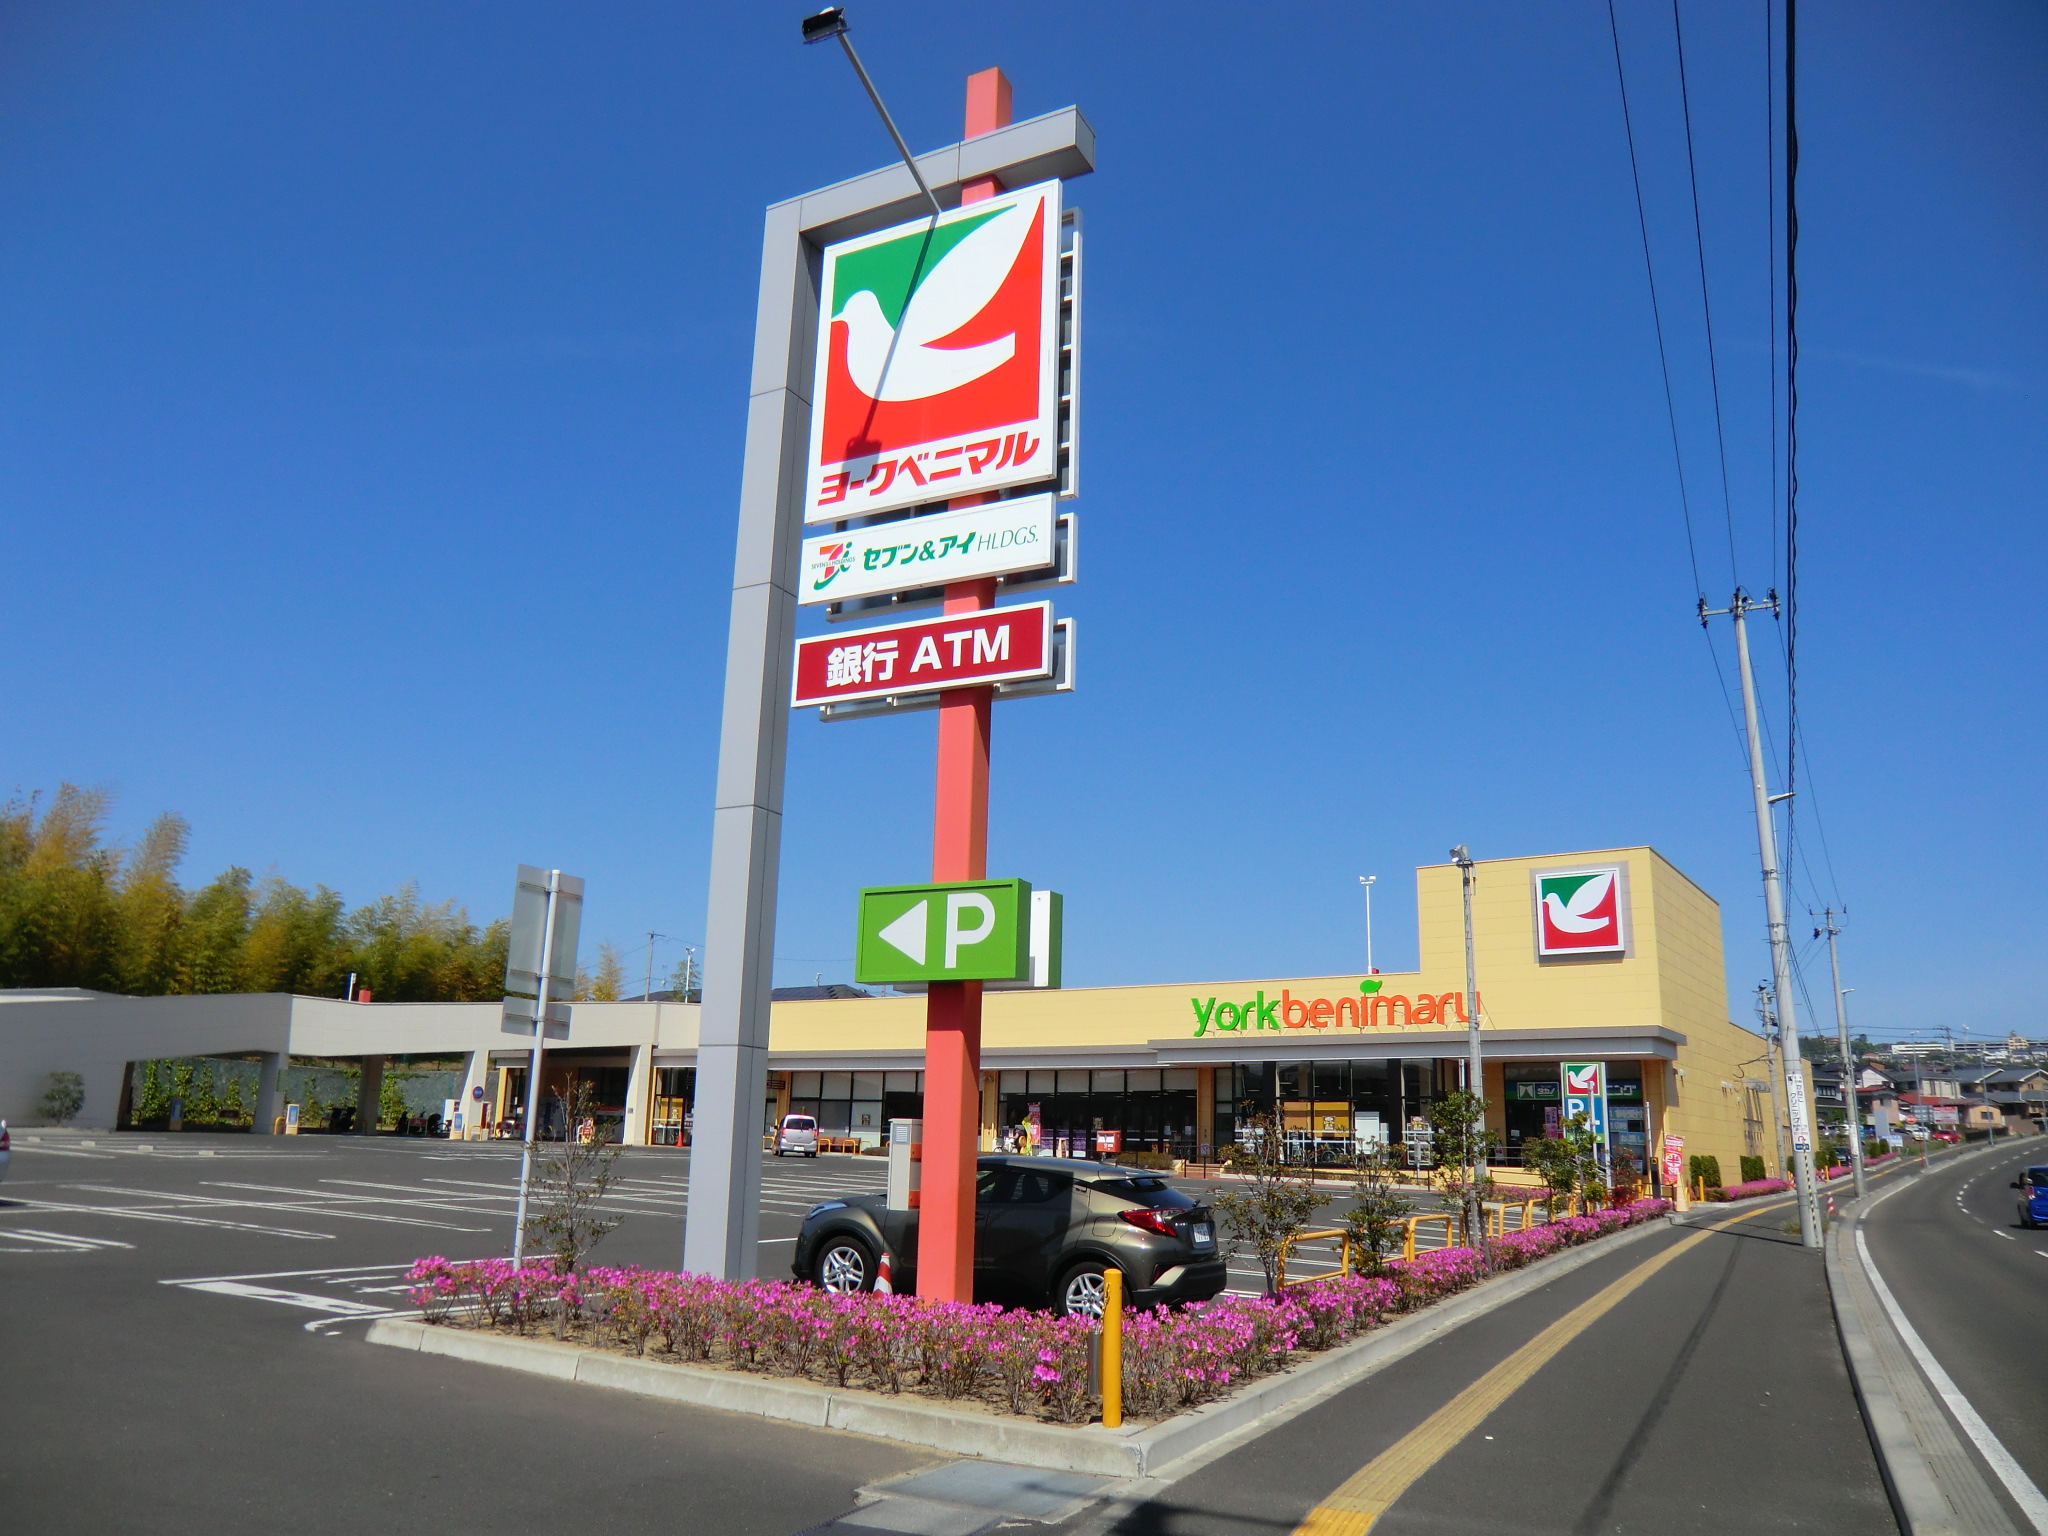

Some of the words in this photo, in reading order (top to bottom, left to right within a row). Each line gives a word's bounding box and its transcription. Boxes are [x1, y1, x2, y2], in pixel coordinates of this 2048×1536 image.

[817, 431, 1040, 506] ヨークベニマル
[863, 532, 977, 571] セブン&アイ
[977, 525, 1039, 553] HLDGS.
[826, 639, 899, 688] 銀行
[909, 624, 1010, 674] ATM
[943, 893, 996, 969] P
